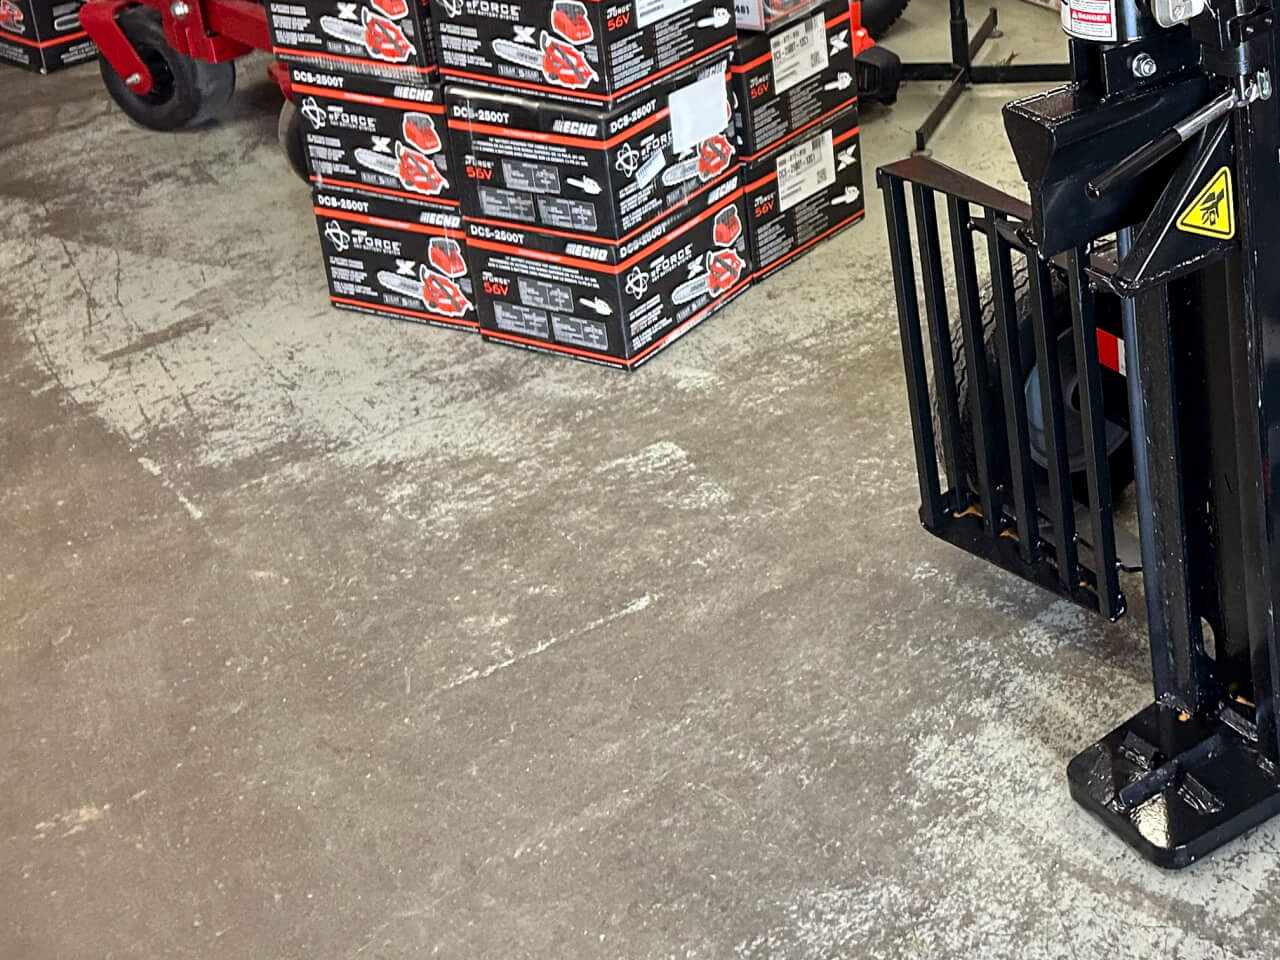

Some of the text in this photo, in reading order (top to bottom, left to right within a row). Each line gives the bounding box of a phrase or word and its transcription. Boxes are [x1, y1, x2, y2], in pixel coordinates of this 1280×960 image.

[607, 12, 631, 32] 56V
[402, 86, 434, 103] ECHO
[564, 121, 598, 137] ECHO
[428, 212, 461, 228] ECHO
[575, 244, 608, 262] ECHO
